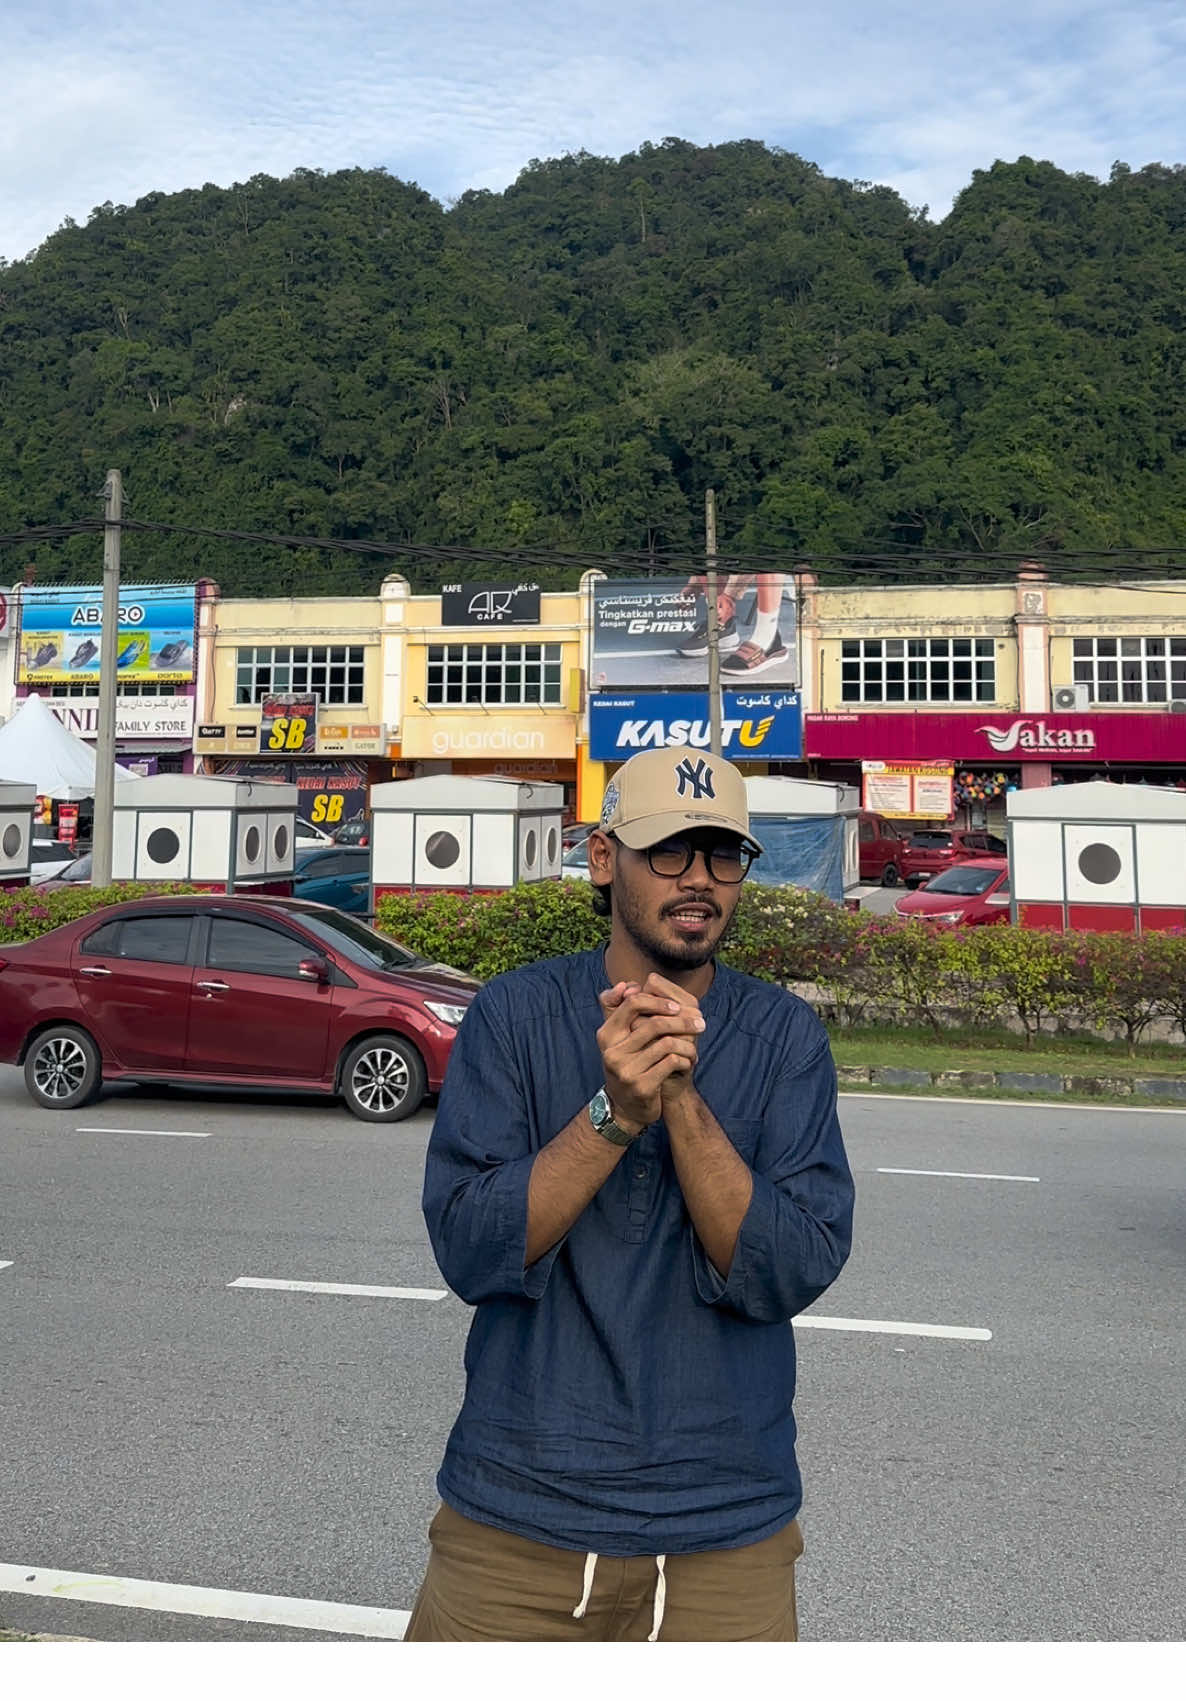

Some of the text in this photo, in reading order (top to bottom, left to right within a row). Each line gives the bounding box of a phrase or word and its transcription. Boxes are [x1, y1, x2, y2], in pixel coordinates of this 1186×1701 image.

[442, 584, 462, 593] KAFE
[72, 605, 144, 626] ABRO
[598, 607, 697, 620] Tingkatkan prestasi
[155, 721, 187, 731] STORE
[268, 718, 307, 749] SB
[616, 715, 775, 747] KASUTU
[432, 728, 544, 754] guardian
[675, 756, 716, 799] NY
[311, 794, 345, 822] SB
